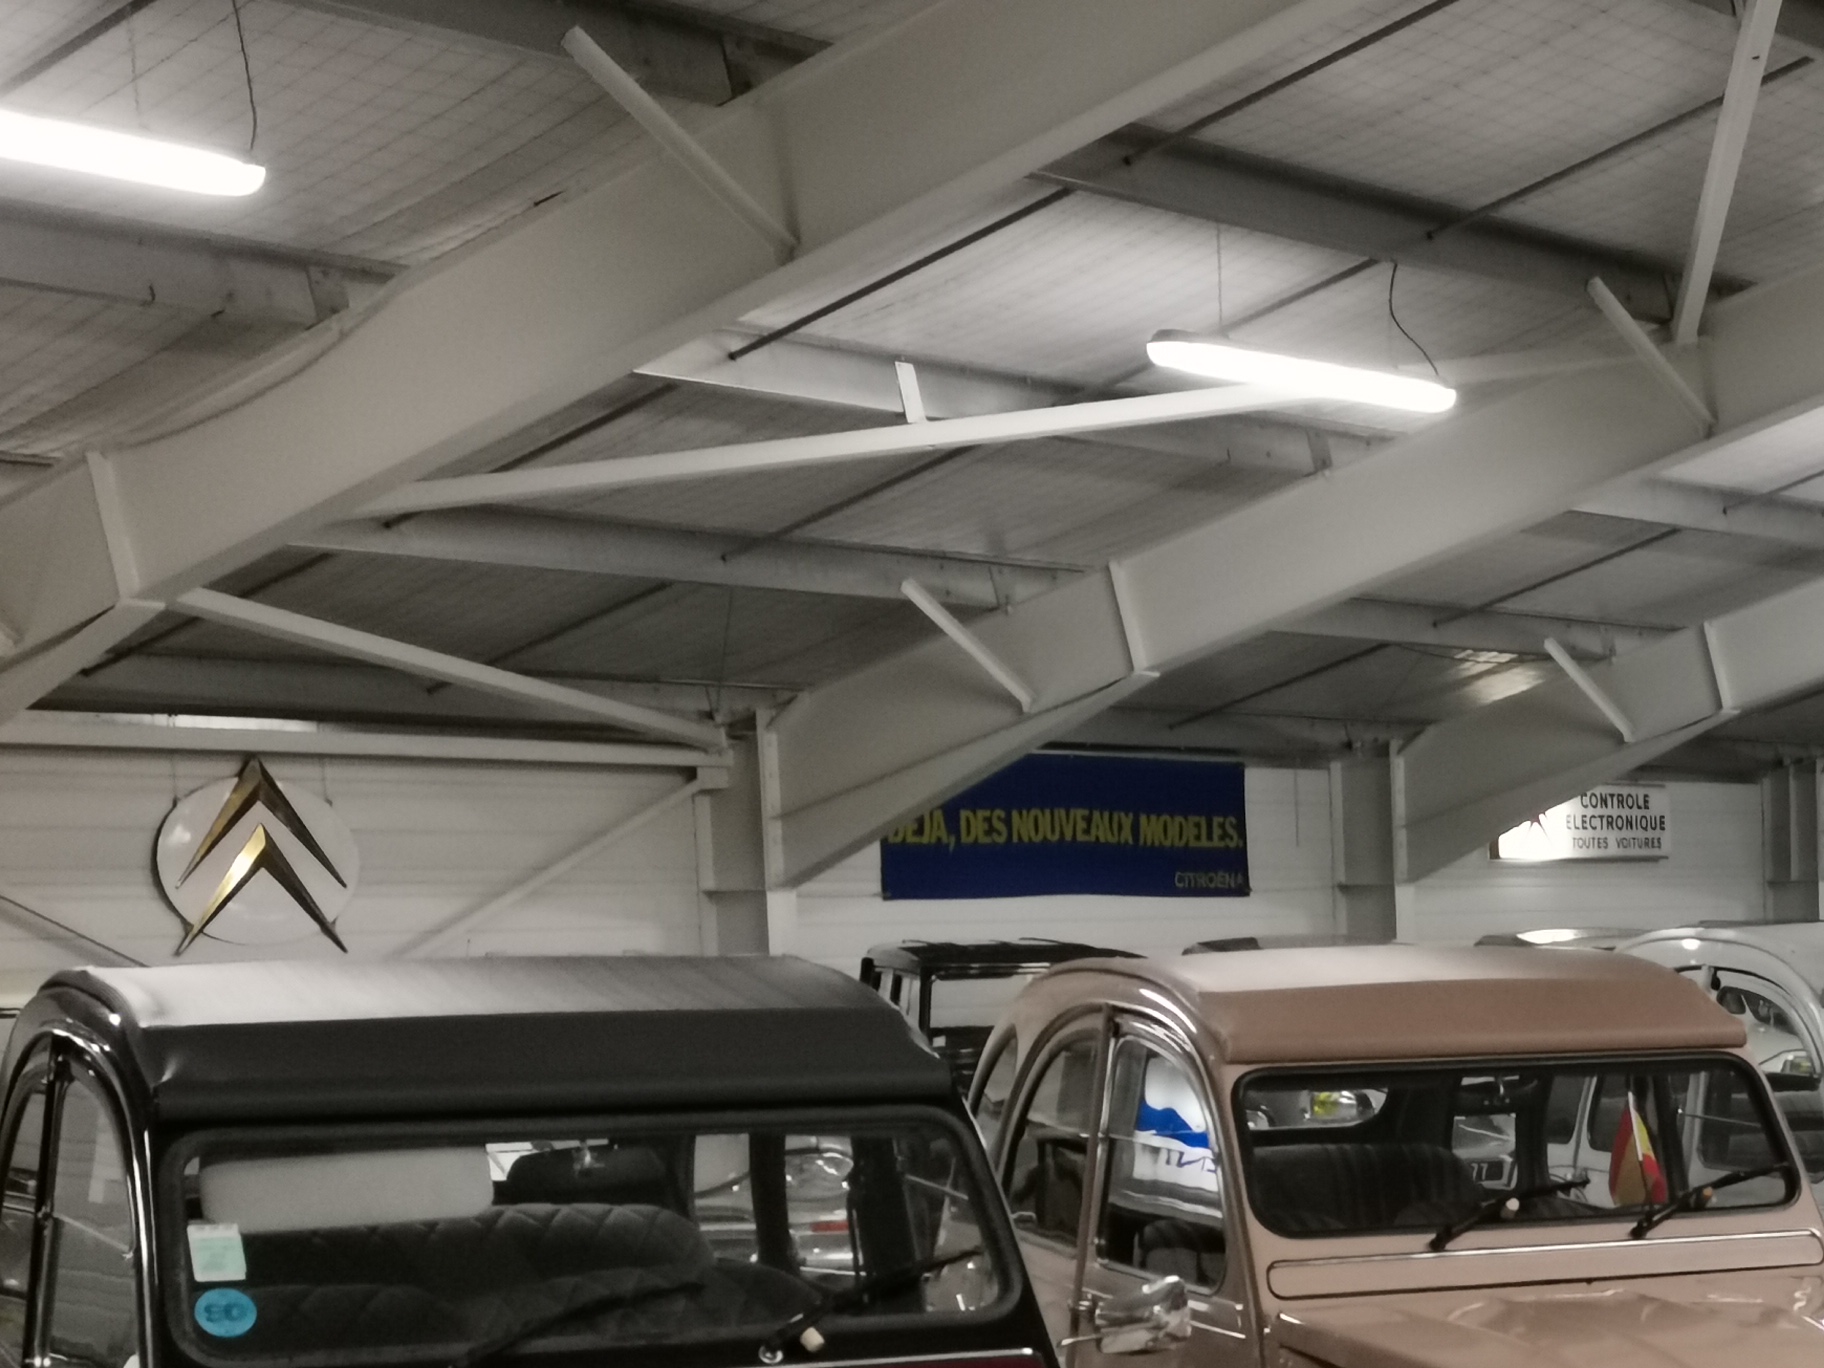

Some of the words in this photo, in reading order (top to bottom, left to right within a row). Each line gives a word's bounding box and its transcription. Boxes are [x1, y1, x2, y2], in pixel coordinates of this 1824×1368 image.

[1580, 791, 1650, 811] CONTROLE
[960, 808, 1008, 843] DES
[1011, 808, 1133, 845] NOUVEAUX
[1139, 813, 1243, 848] MODELES.
[1566, 814, 1666, 832] ELECTRONIQUE
[1572, 836, 1608, 850] TOUTES
[1615, 836, 1663, 850] VOITURES
